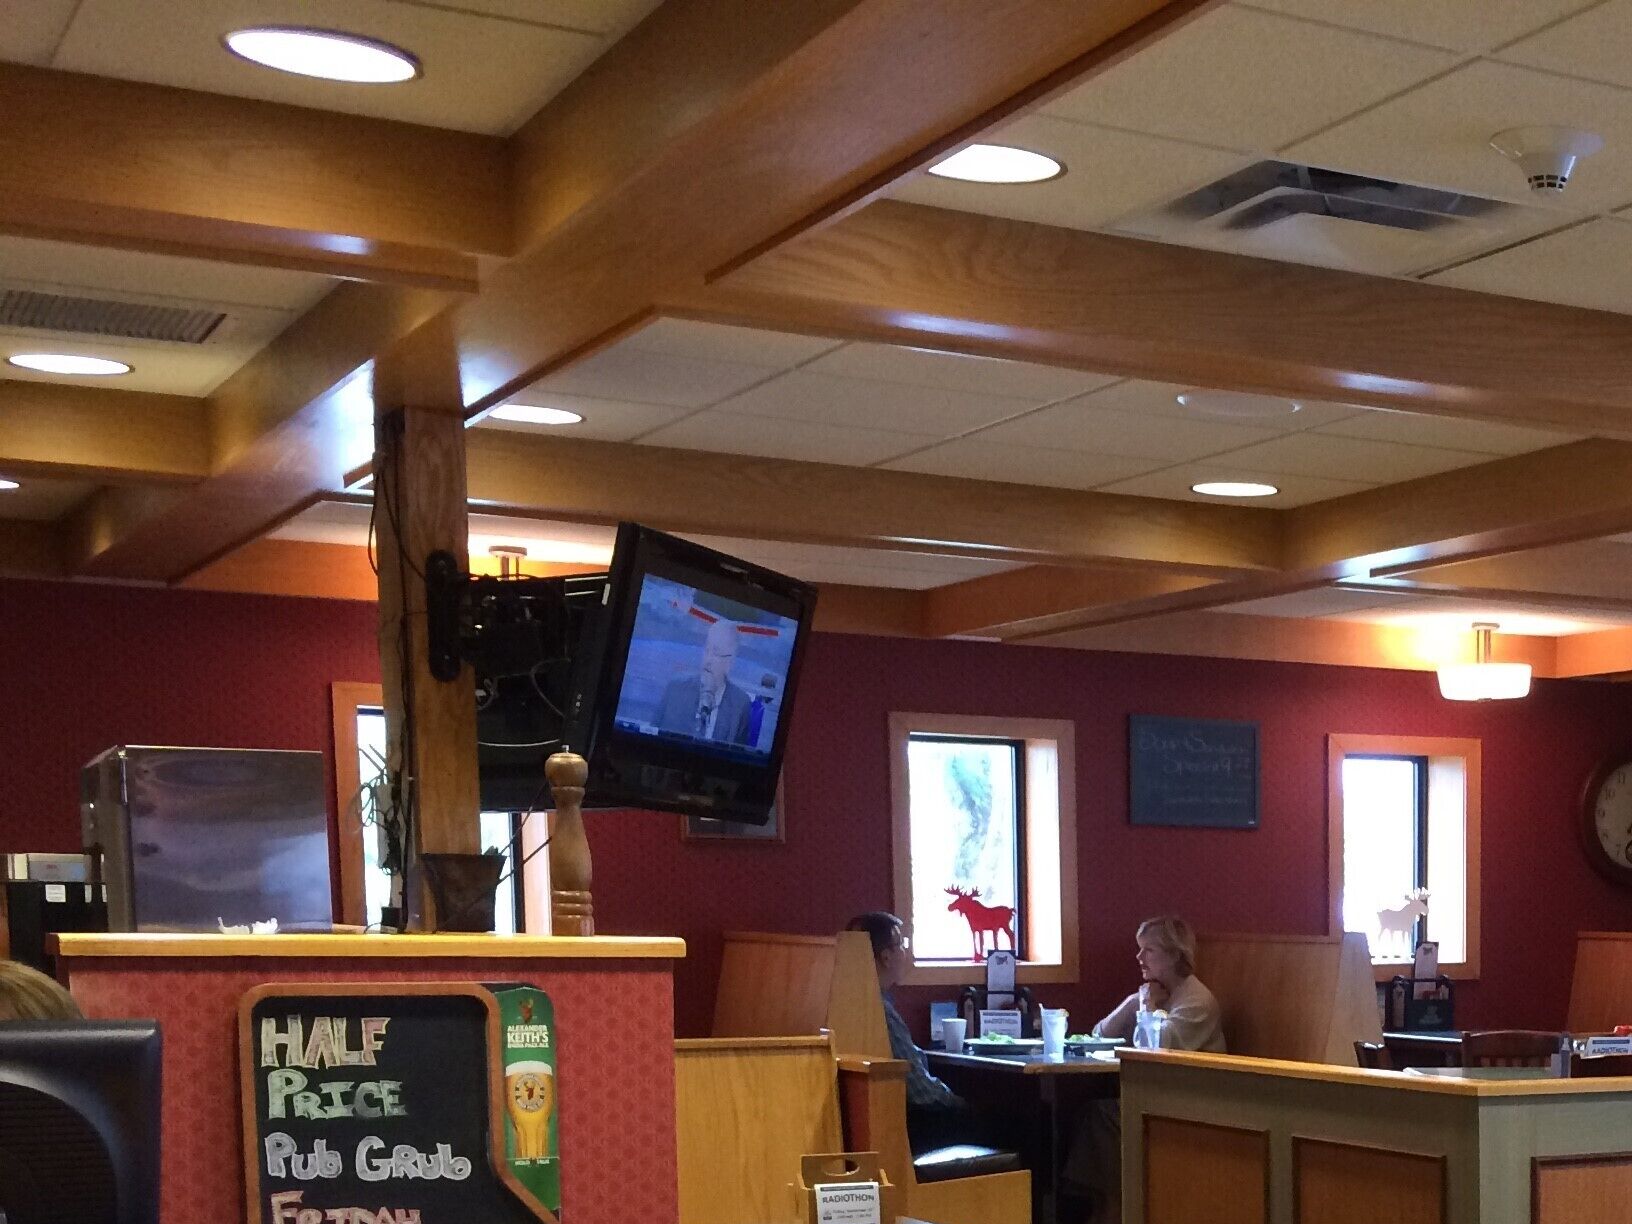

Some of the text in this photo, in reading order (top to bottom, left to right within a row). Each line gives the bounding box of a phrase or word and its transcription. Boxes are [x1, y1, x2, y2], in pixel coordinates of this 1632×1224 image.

[261, 1014, 391, 1069] HALF
[507, 1031, 550, 1043] KEITH'S
[267, 1068, 408, 1119] PRICE
[264, 1131, 343, 1180] Pub
[822, 1193, 874, 1204] RADIOTHON
